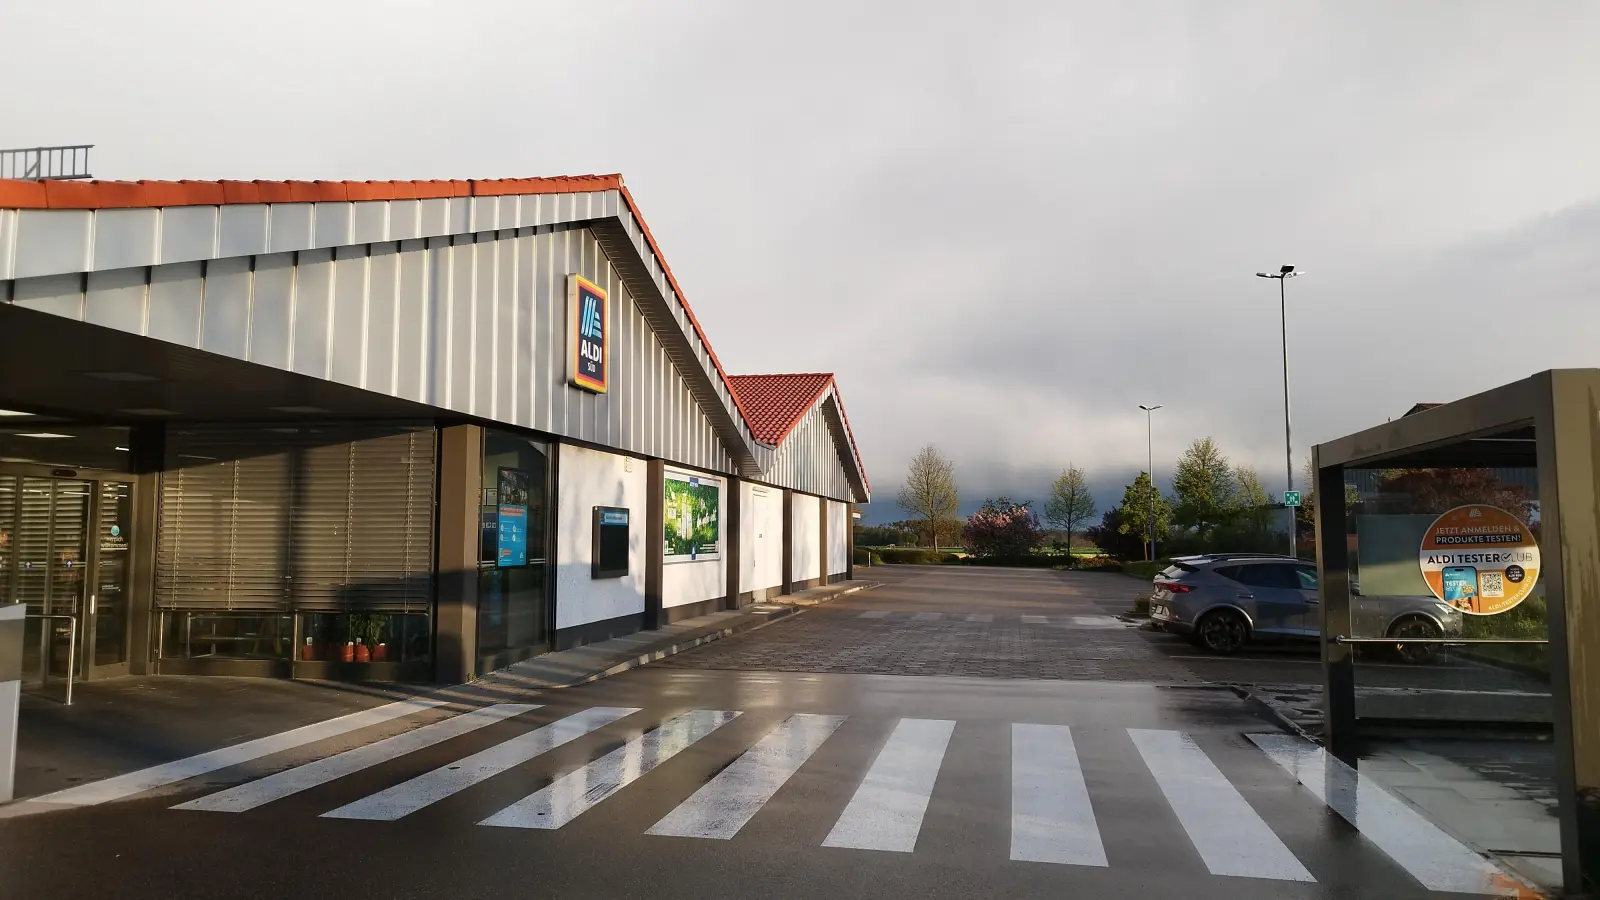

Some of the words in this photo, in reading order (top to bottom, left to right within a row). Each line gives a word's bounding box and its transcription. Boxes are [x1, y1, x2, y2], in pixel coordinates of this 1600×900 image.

[580, 339, 602, 364] ALDI
[587, 361, 596, 373] SÜD
[1435, 527, 1459, 535] JETZT
[1461, 525, 1512, 534] ANMELDEN
[1435, 535, 1484, 544] PRODUKTE
[1487, 534, 1521, 543] TESTEN!
[1427, 554, 1455, 565] ALDI
